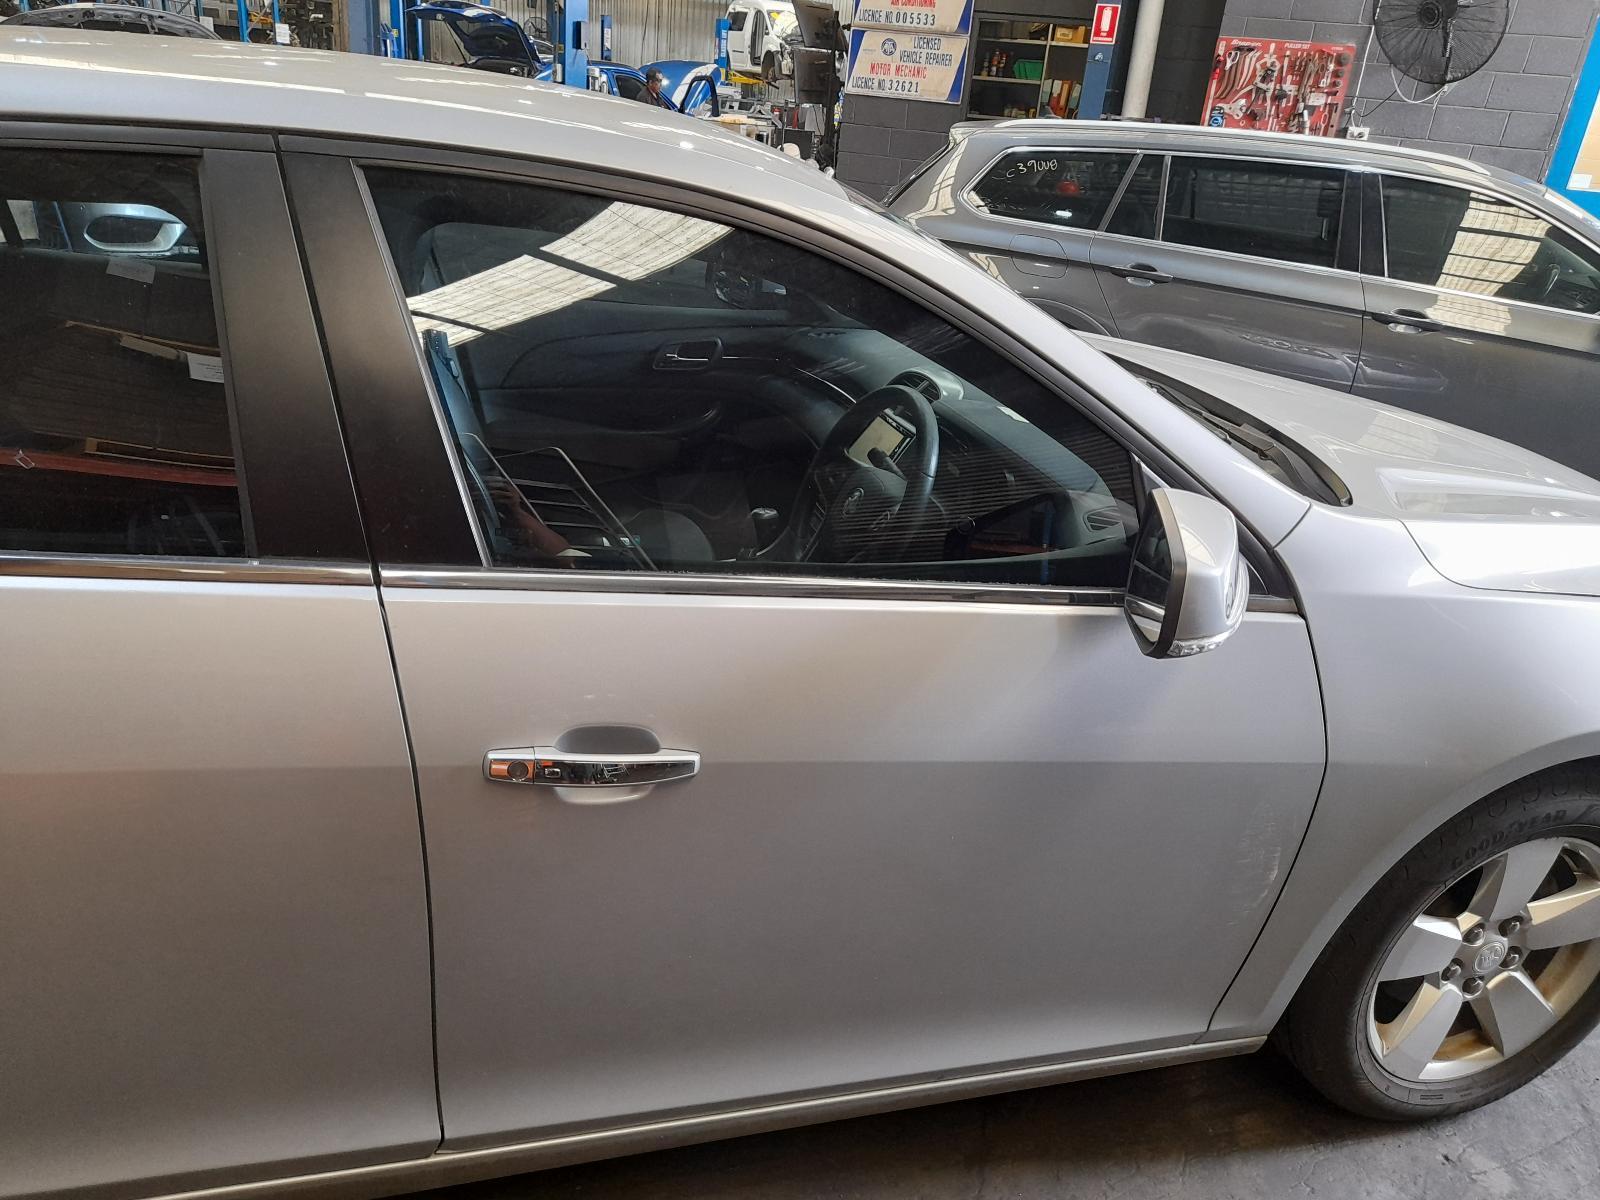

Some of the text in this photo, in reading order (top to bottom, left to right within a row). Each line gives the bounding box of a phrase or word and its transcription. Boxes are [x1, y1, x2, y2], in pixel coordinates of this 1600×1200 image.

[859, 9, 882, 22] LICENCE
[895, 11, 935, 26] 005533
[914, 36, 941, 51] LICENSED
[900, 50, 952, 67] VEHICLE REPAIRER
[870, 63, 927, 79] MOTOR MECHANIC
[852, 77, 874, 90] LICENCE
[888, 79, 919, 92] 32621
